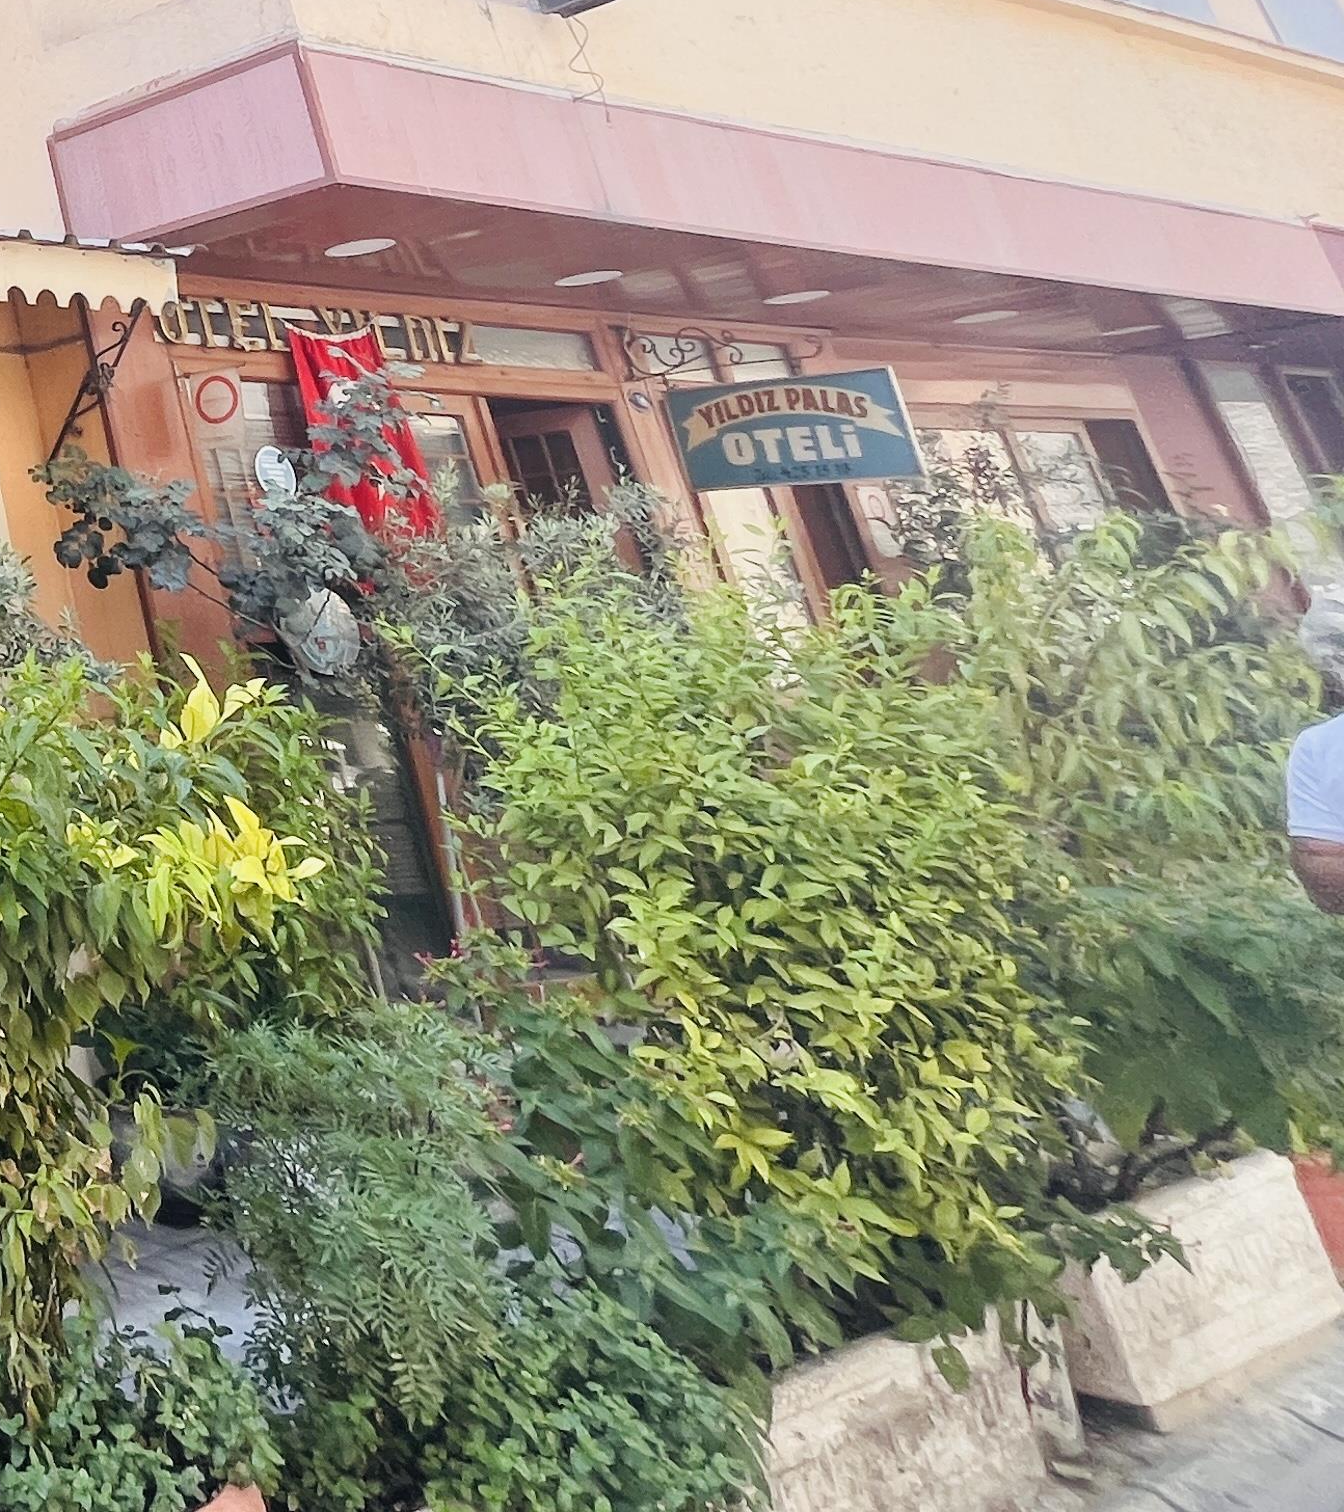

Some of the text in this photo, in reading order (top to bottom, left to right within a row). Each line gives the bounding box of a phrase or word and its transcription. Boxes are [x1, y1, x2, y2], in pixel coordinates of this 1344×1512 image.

[160, 296, 291, 354] OTEL
[697, 387, 869, 429] YILDIZ PALAS
